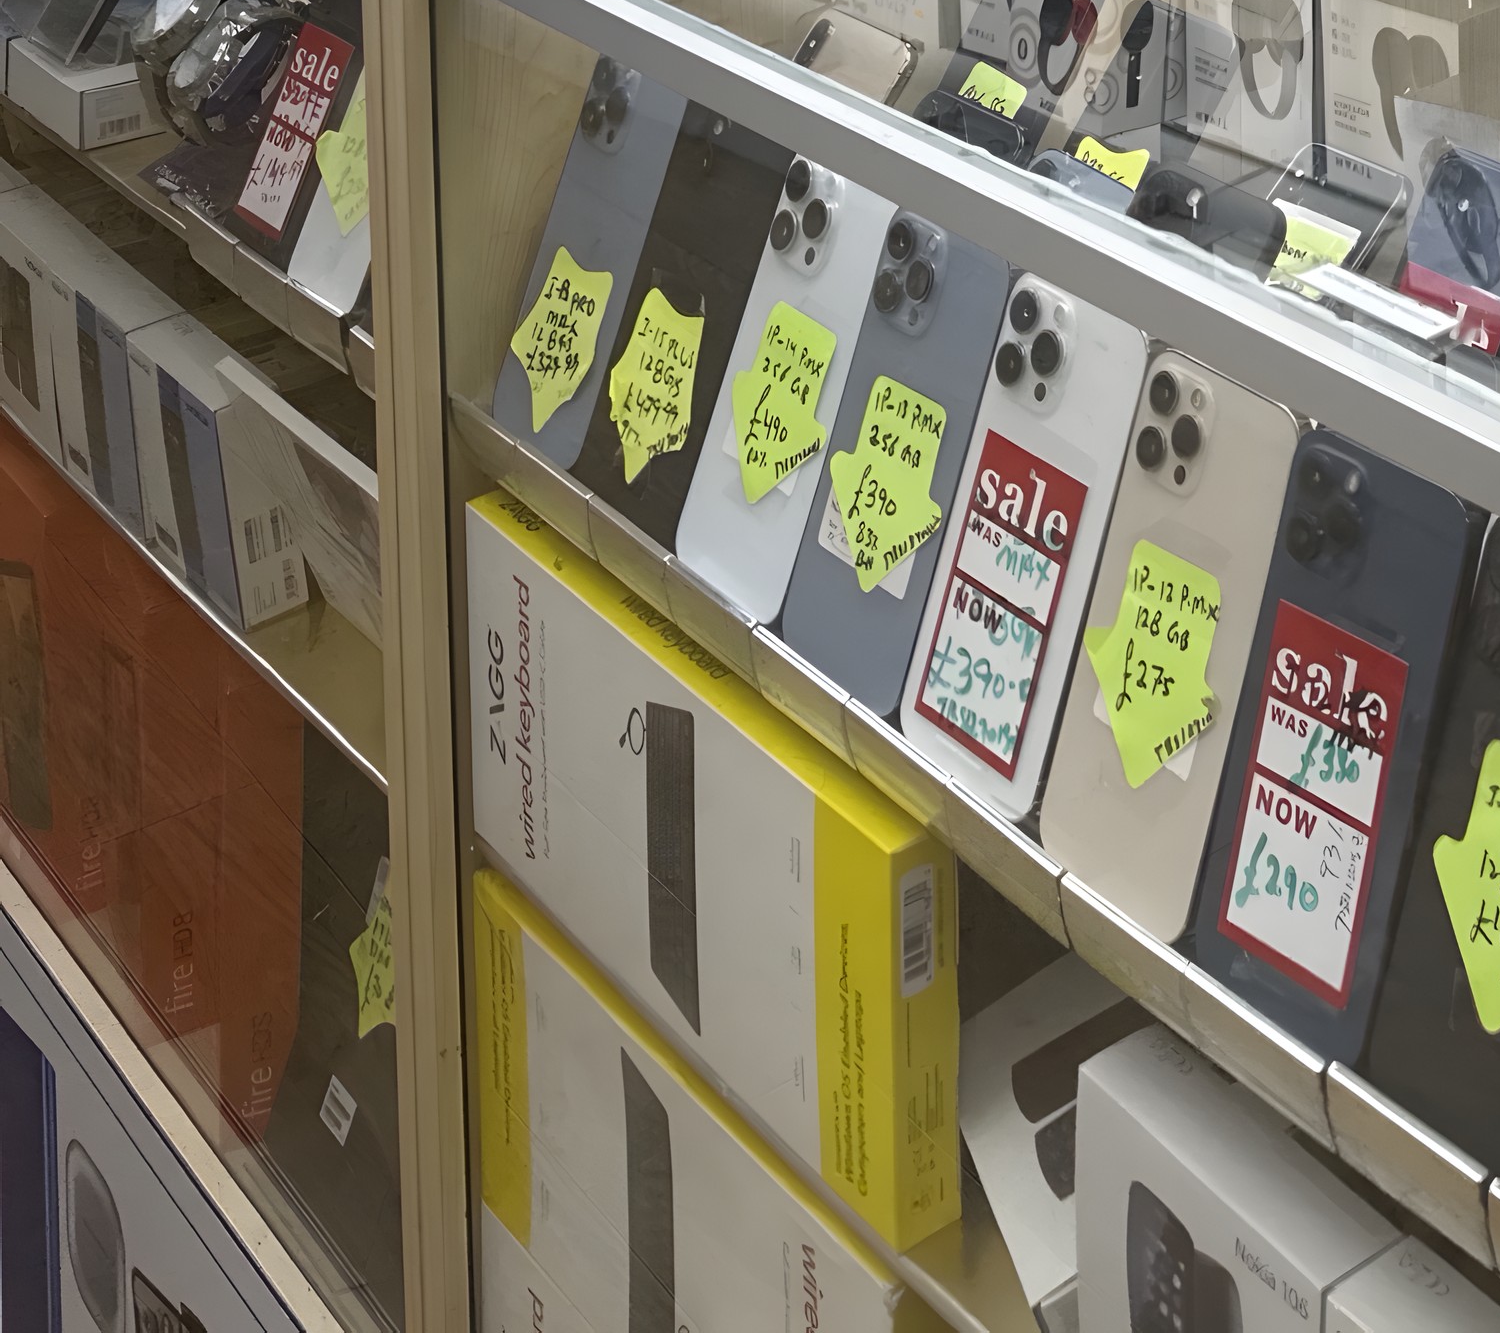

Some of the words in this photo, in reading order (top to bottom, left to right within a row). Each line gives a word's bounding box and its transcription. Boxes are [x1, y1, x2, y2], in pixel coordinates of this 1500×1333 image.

[291, 47, 340, 92] sale
[744, 384, 788, 446] £490
[848, 464, 897, 520] £390
[975, 467, 1069, 552] sale
[970, 516, 1002, 548] WAS
[952, 583, 1002, 635] NOW
[1166, 621, 1190, 651] GB
[513, 575, 536, 753] keyboard
[1115, 638, 1175, 712] £275
[488, 629, 507, 765] ZAGG
[1270, 703, 1308, 738] WAS
[1271, 646, 1388, 740] sale
[516, 753, 536, 860] wired
[1255, 784, 1318, 840] NOW
[75, 842, 102, 891] fire
[1235, 832, 1319, 912] £290
[165, 957, 194, 1015] fire
[241, 1064, 272, 1121] fire
